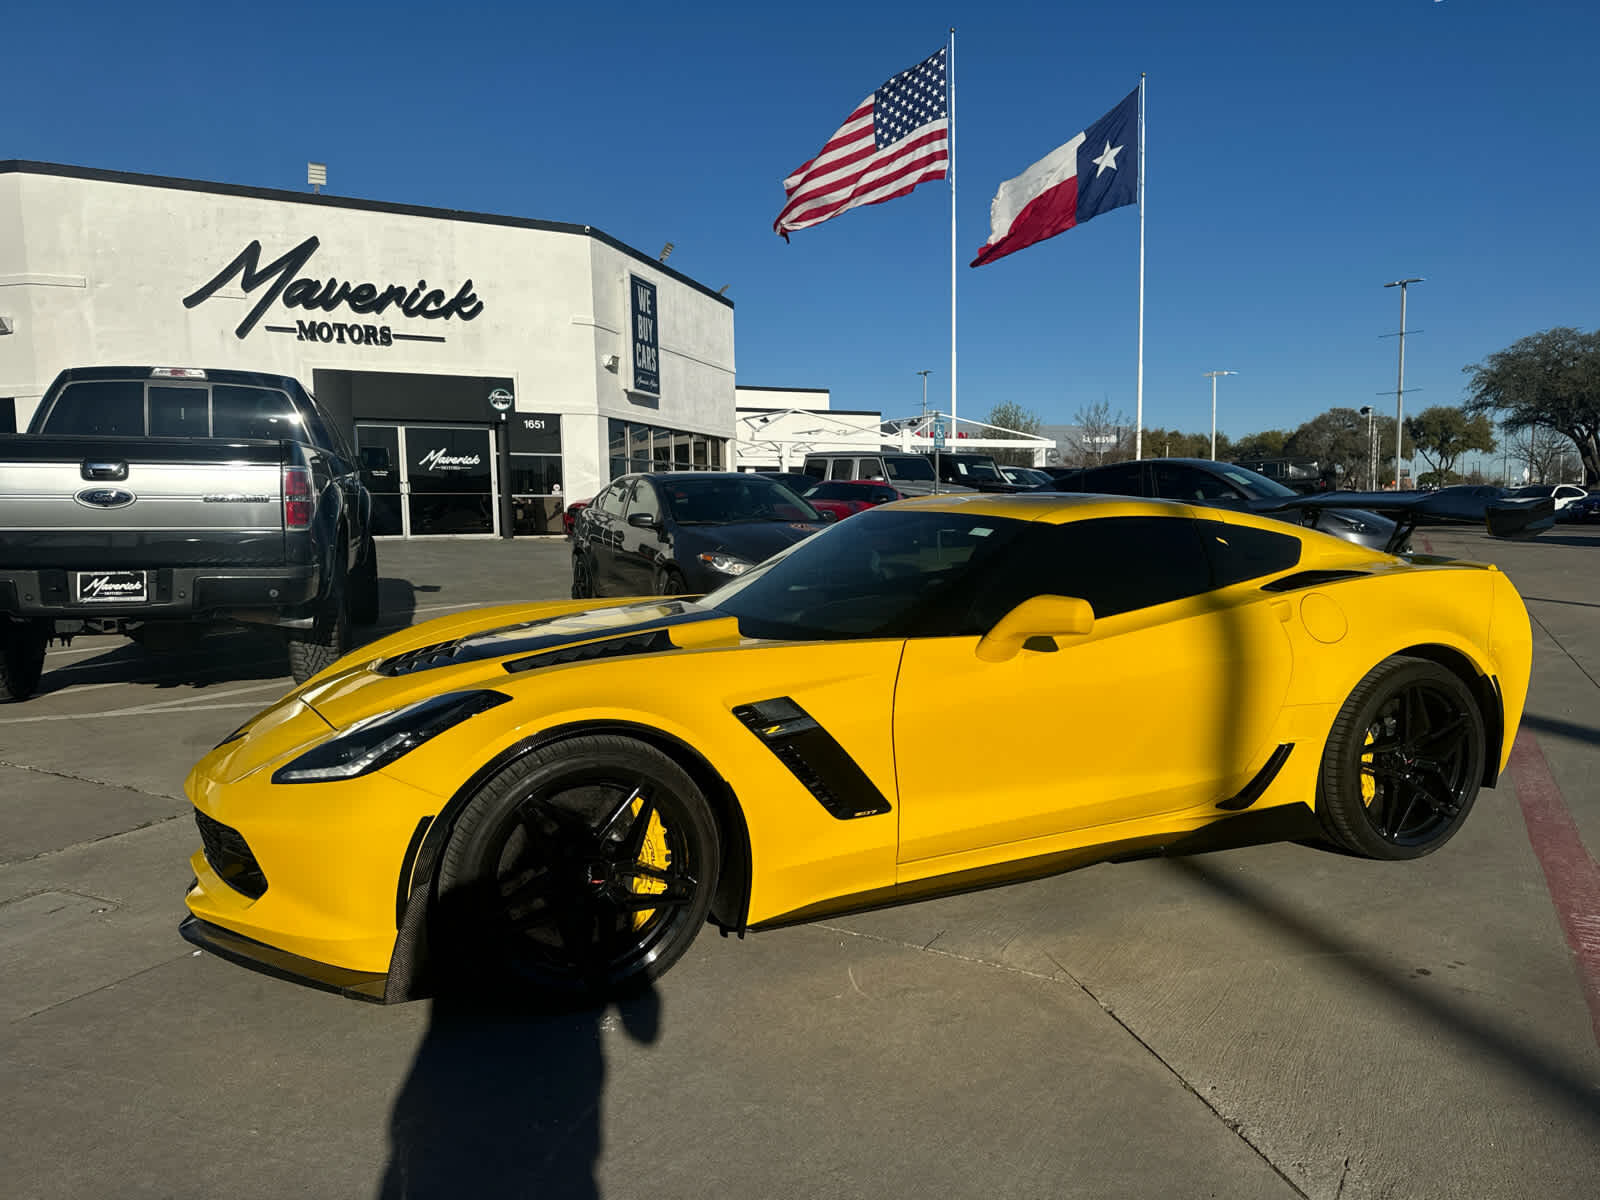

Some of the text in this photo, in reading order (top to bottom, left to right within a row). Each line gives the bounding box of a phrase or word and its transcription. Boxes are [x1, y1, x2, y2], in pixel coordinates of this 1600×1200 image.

[182, 235, 484, 340] Maverick
[637, 285, 652, 314] WE
[296, 319, 393, 347] MOTORS
[637, 314, 653, 343] BUY
[636, 342, 656, 372] CARS
[523, 419, 545, 429] 1651
[418, 447, 481, 471] Maverick
[82, 576, 142, 596] Maverick
